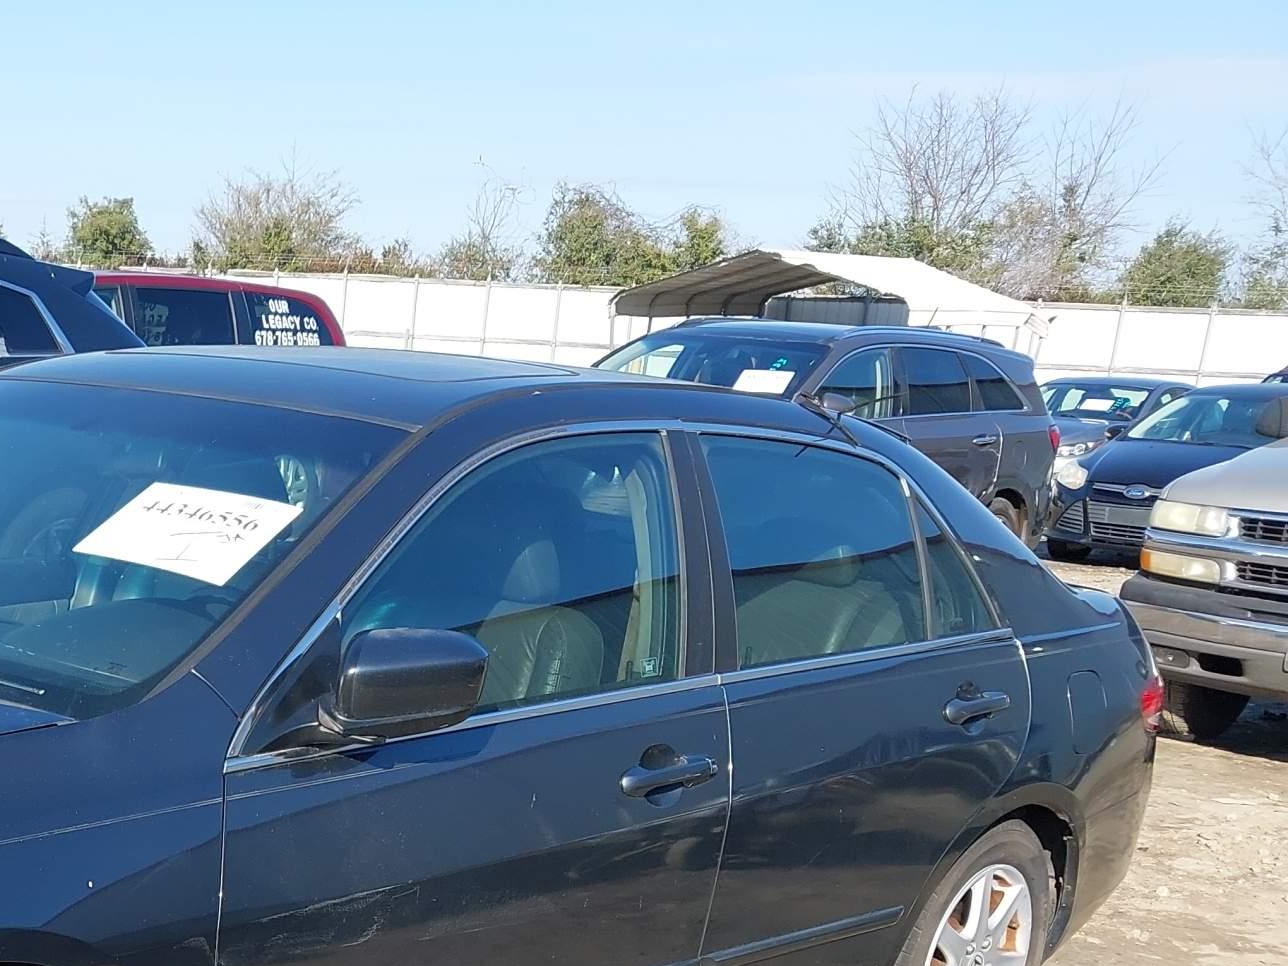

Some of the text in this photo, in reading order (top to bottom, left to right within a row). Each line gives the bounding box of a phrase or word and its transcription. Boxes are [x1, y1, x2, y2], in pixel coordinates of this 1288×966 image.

[268, 298, 290, 314] OUR
[261, 314, 301, 330] LEGACY
[142, 500, 259, 532] 44346556
